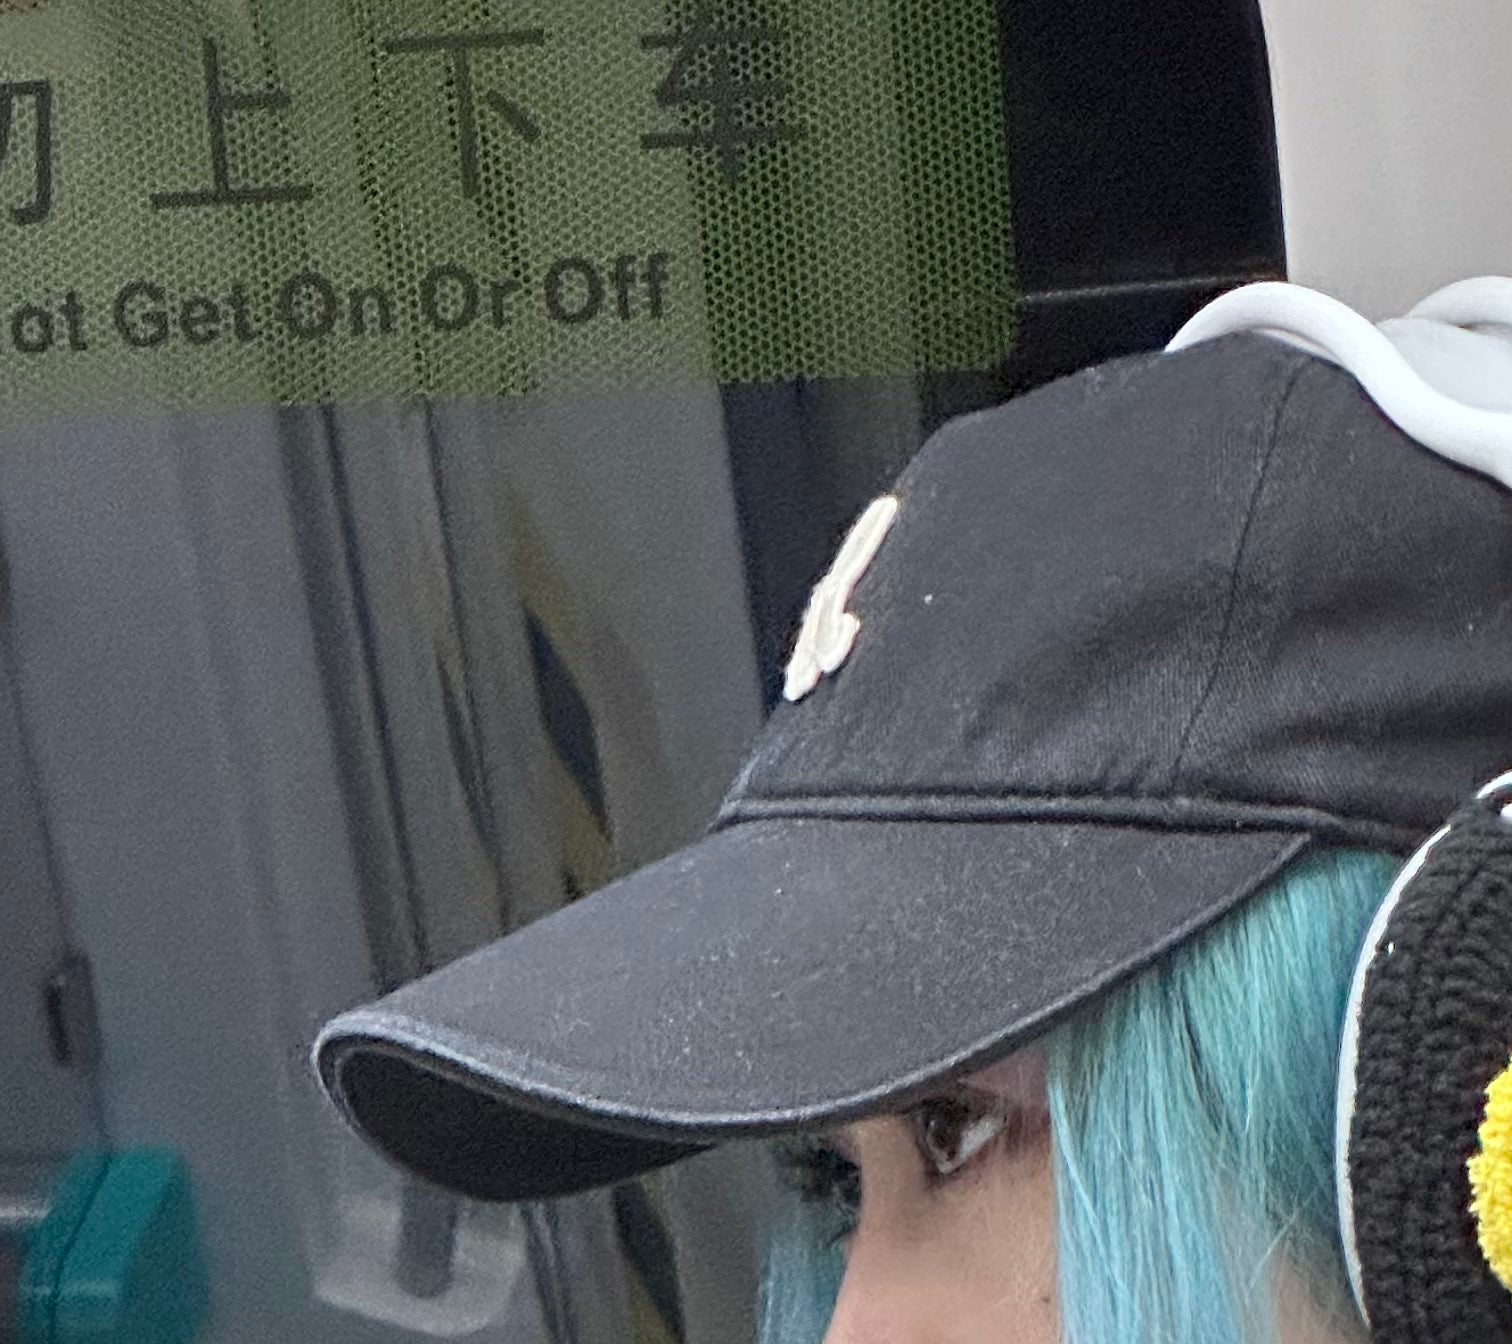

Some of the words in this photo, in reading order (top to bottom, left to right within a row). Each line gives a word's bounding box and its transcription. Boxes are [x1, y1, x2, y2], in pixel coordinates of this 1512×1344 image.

[112, 276, 252, 348] Get
[279, 270, 393, 340] On
[419, 262, 522, 332] Or
[544, 253, 670, 324] Off
